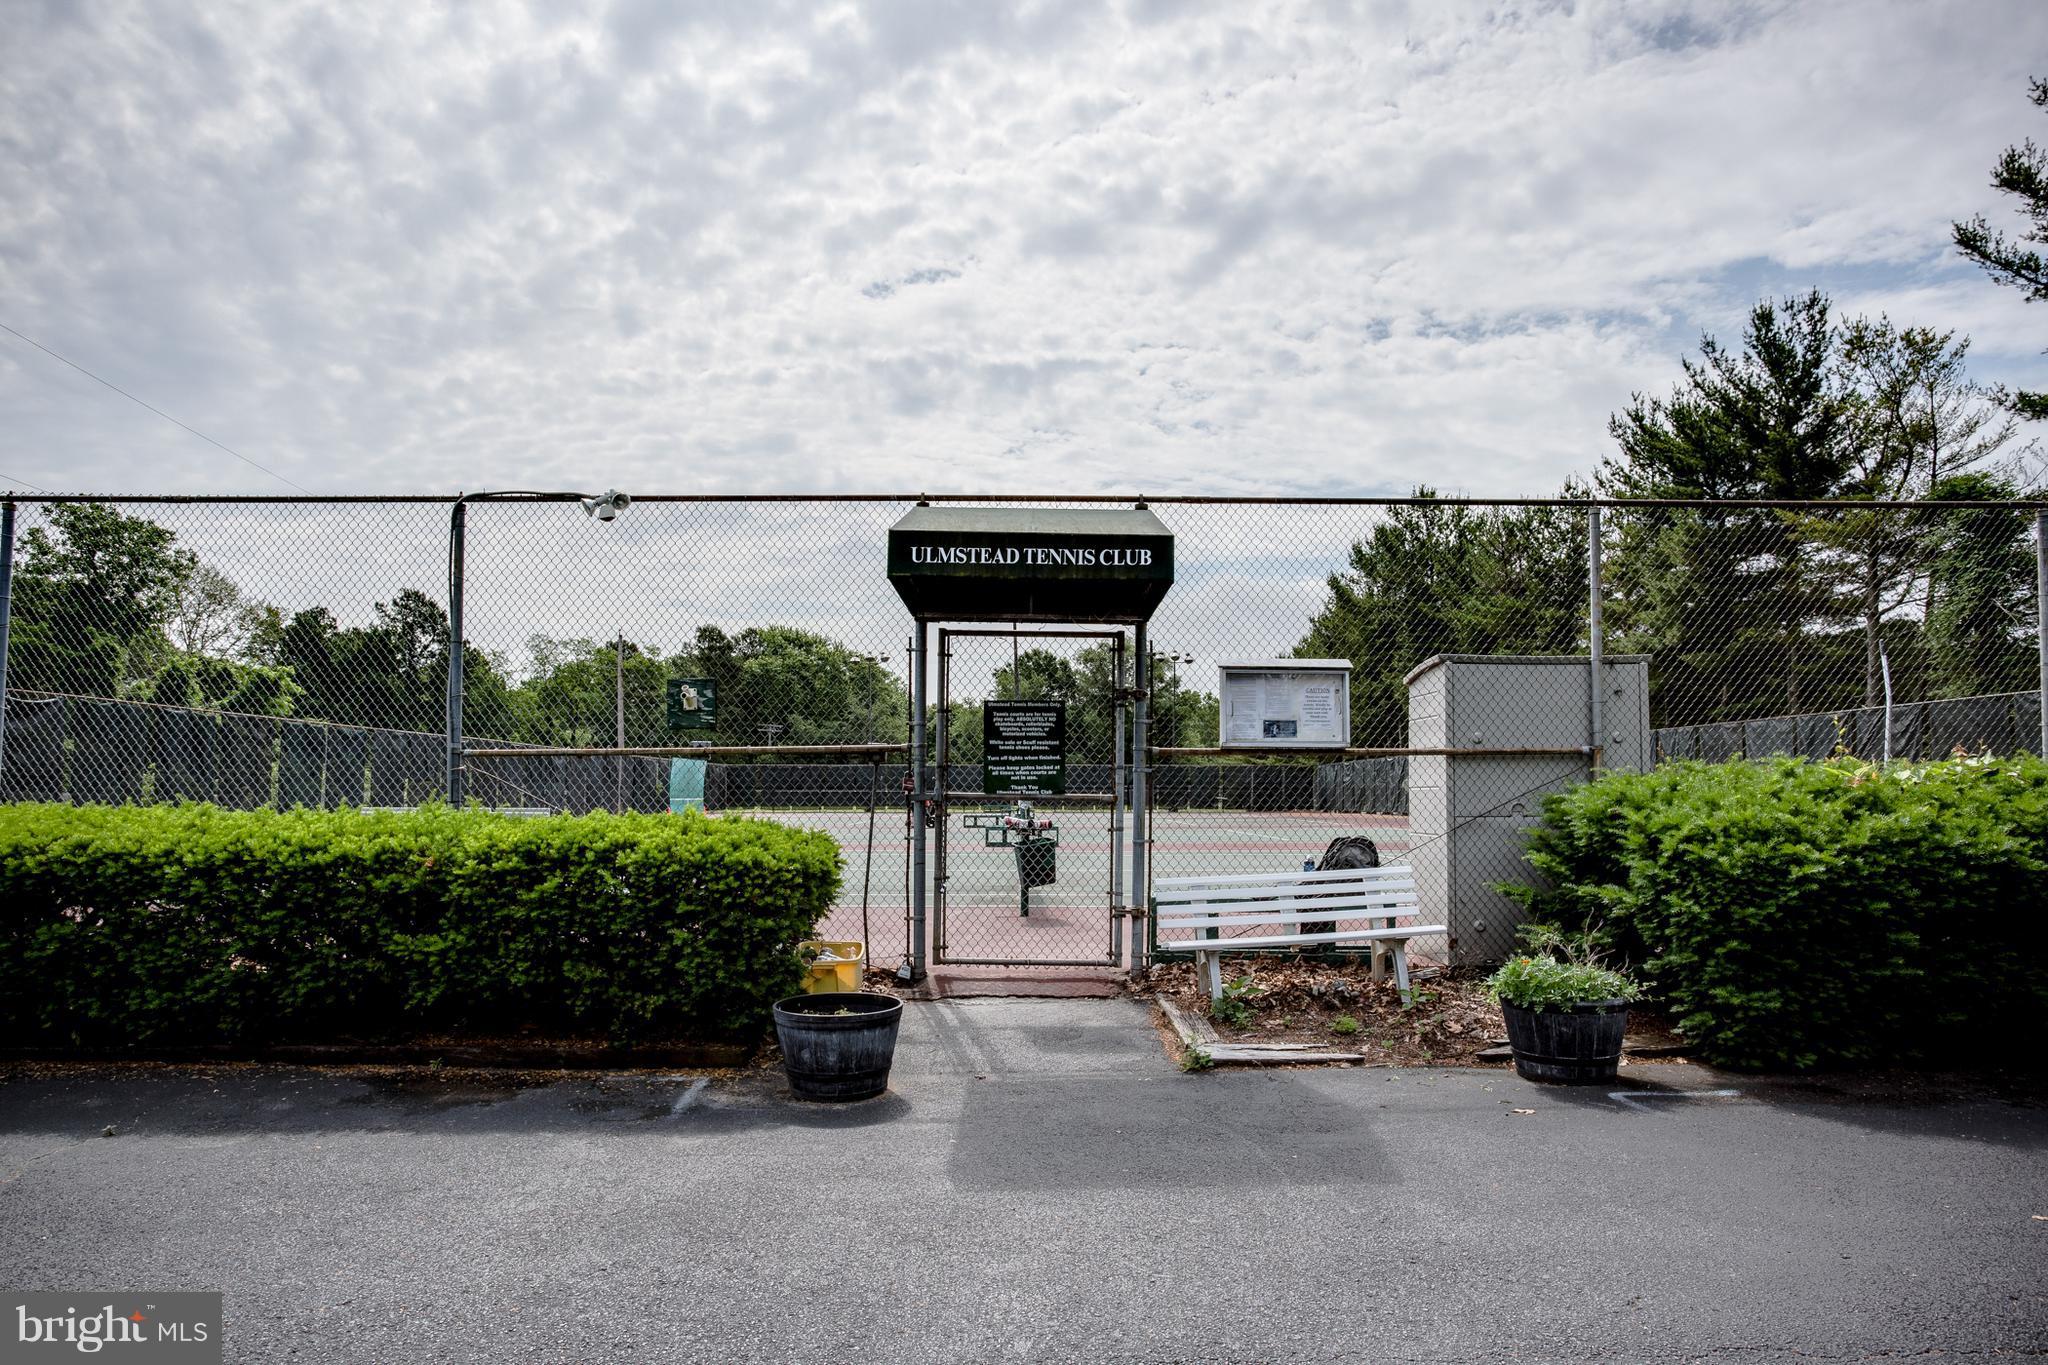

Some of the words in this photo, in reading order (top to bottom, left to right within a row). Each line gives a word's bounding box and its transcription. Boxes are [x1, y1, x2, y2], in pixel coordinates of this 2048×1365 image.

[911, 546, 1020, 564] ULMSTEAD
[1023, 548, 1096, 565] TENNIS
[1099, 549, 1153, 566] CLUB
